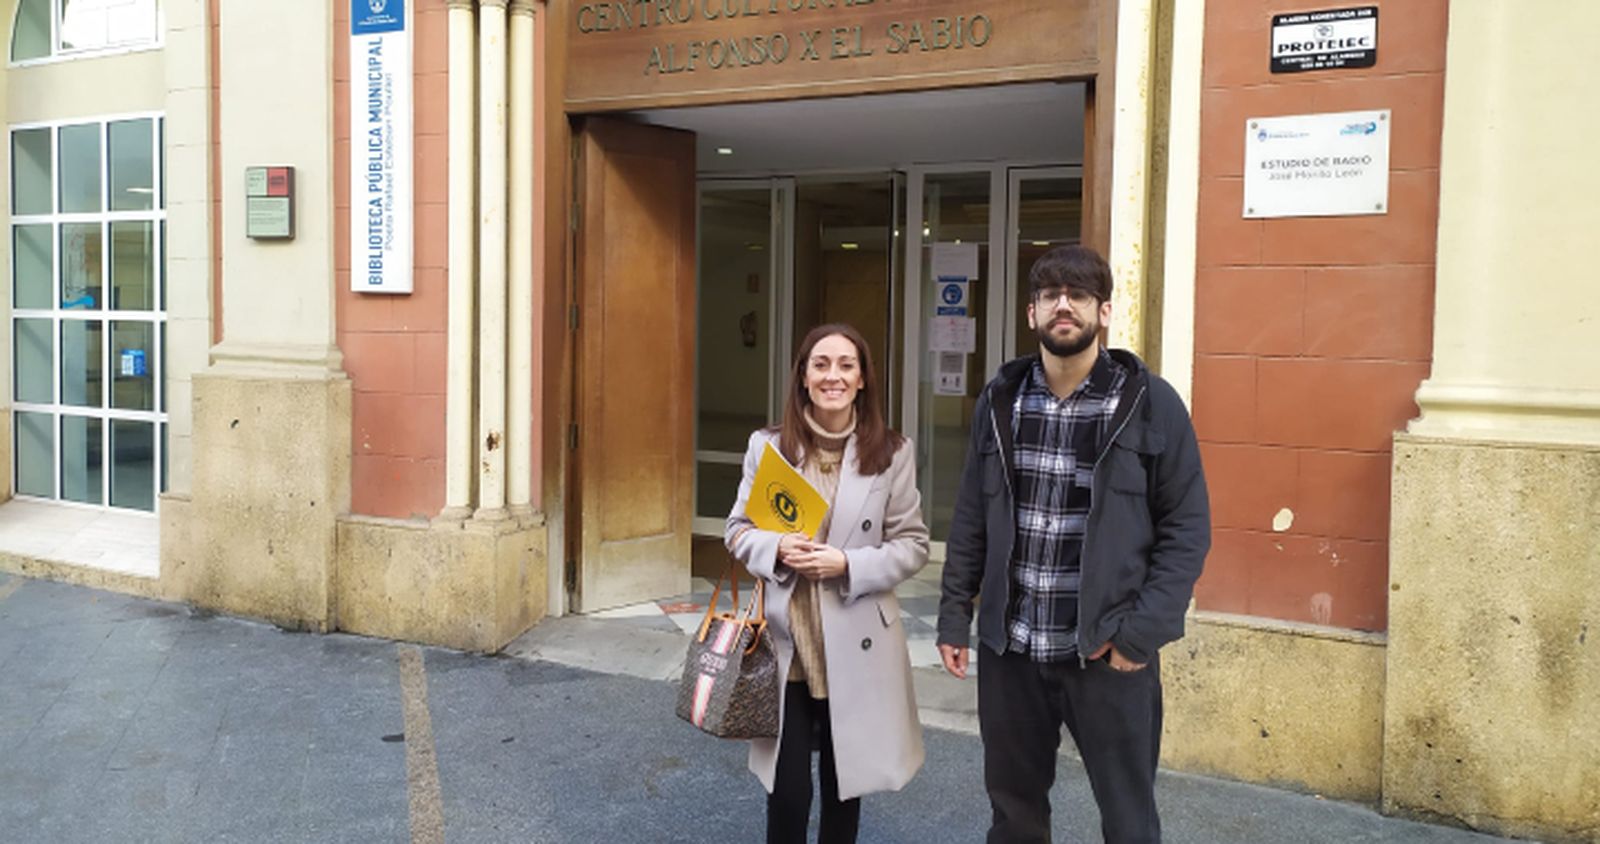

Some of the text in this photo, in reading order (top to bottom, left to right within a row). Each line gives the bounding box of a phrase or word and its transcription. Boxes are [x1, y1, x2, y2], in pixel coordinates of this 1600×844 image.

[577, 0, 694, 33] CENTRO
[643, 15, 992, 75] ALFONSO X EL SABIO
[1278, 36, 1370, 53] PROTELEC
[364, 36, 383, 285] BIBLIOTECA PÚBLICA MUNICIPAL
[1261, 154, 1372, 169] ESTUDIO DE RADIO
